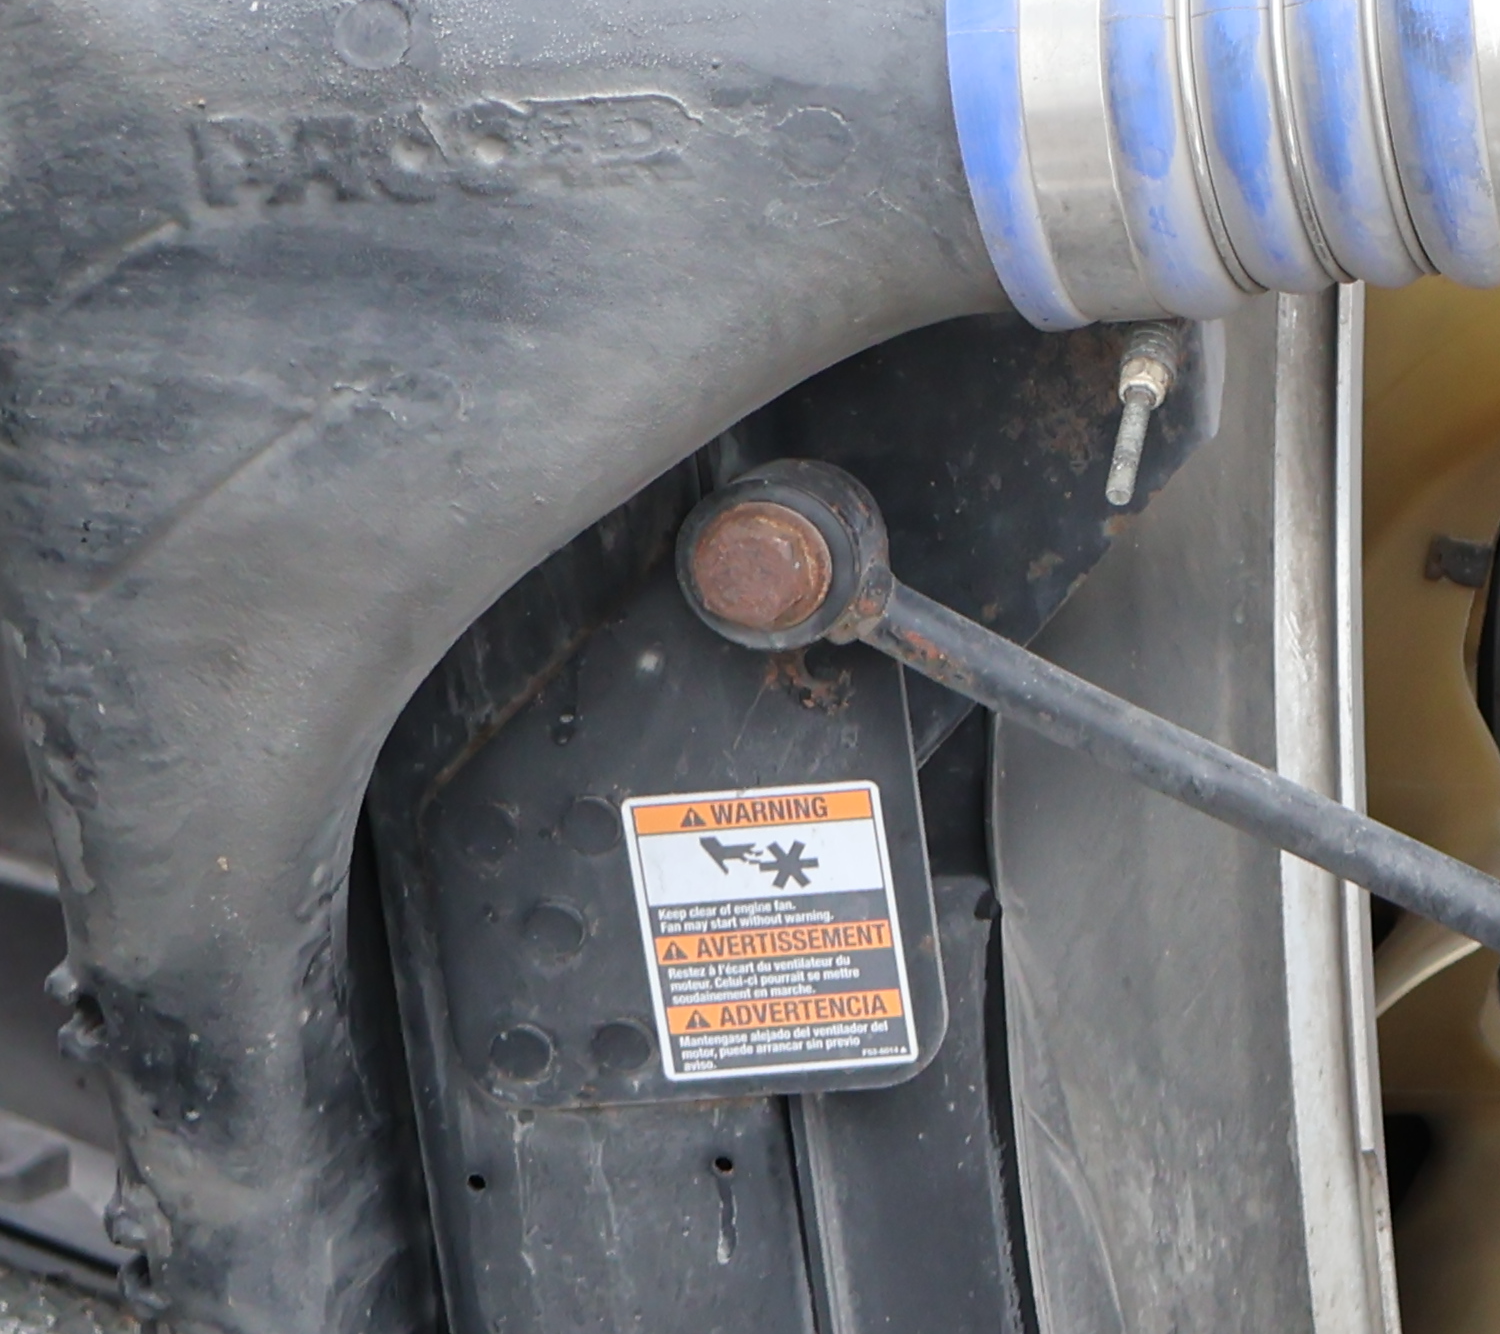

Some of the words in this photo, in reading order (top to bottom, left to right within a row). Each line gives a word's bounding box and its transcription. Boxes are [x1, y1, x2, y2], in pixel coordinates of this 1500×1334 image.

[709, 796, 828, 825] WARNING
[658, 907, 686, 922] Keep
[688, 905, 717, 918] clear
[719, 904, 731, 915] of
[733, 901, 772, 916] engine
[773, 899, 795, 911] fan.
[660, 921, 681, 933] Fan
[683, 922, 708, 933] may
[710, 917, 737, 929] start
[739, 913, 782, 927] without
[784, 909, 833, 925] warning.
[694, 922, 887, 959] AVERTISSEMENT
[667, 965, 705, 979] Restez
[756, 960, 771, 972] du
[773, 955, 833, 971] ventilateur
[835, 953, 850, 966] du
[714, 975, 758, 989] Celui-ci
[759, 971, 805, 987] pourrait
[806, 972, 821, 982] se
[822, 967, 859, 980] mettre
[671, 988, 751, 1005] soudainement
[753, 989, 767, 998] en
[769, 983, 815, 997] marche.
[717, 992, 887, 1027] ADVERTENCIA
[678, 1031, 748, 1049] Mantengase
[749, 1027, 791, 1043] alejado
[792, 1026, 810, 1038] del
[812, 1021, 868, 1036] ventilador
[870, 1019, 887, 1032] del
[681, 1047, 717, 1061] motor,
[718, 1044, 754, 1058] puede
[756, 1042, 804, 1053] arrancar
[805, 1038, 823, 1049] sin
[825, 1035, 860, 1049] previo
[683, 1060, 716, 1071] aviso.
